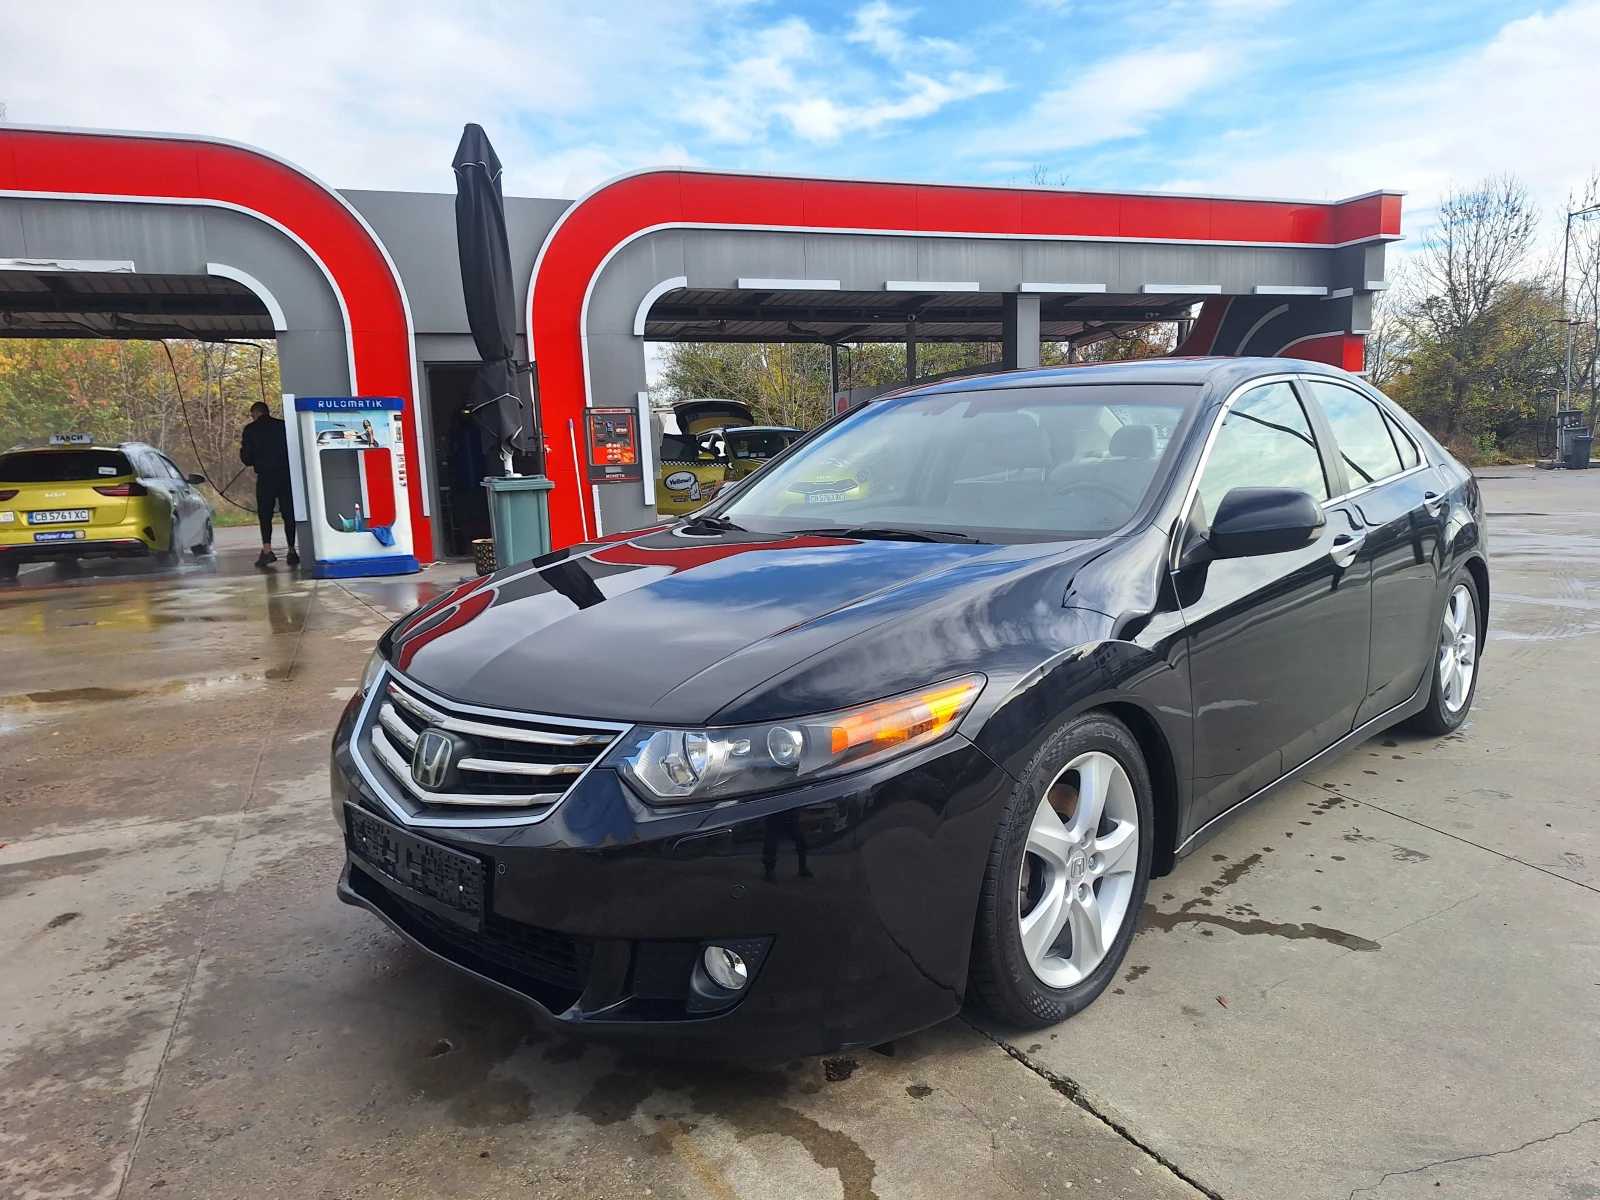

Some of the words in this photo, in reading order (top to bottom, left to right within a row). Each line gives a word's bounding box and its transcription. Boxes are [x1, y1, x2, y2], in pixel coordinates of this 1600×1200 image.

[318, 400, 383, 408] RULOMATIK
[669, 477, 692, 486] Yellow!
[48, 511, 72, 521] 5761
